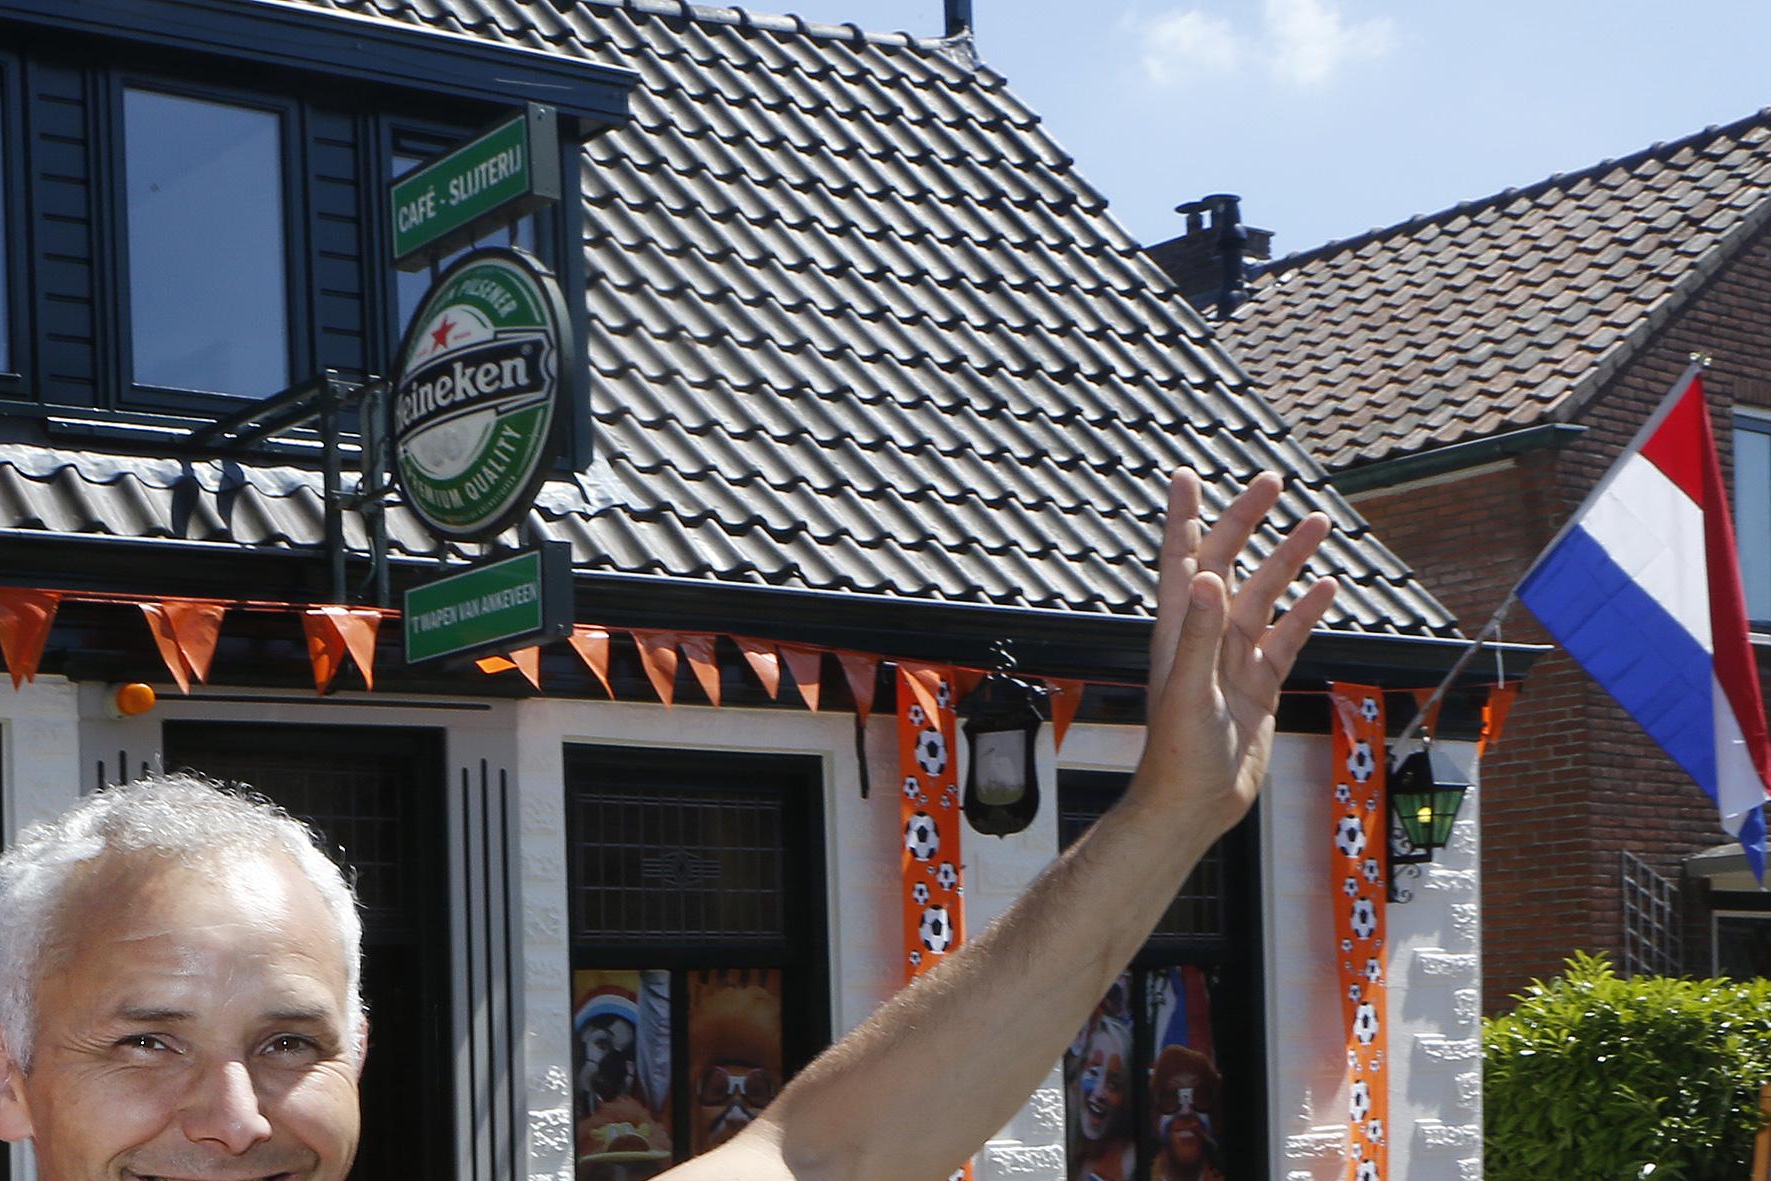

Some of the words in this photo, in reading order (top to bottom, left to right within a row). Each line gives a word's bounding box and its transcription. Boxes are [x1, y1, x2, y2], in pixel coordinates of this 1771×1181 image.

[398, 184, 436, 233] CAFÉ
[449, 144, 522, 206] SLIJTERIJ
[464, 424, 522, 501] QUALITY
[420, 605, 458, 632] WAPEN
[458, 598, 480, 622] VAN
